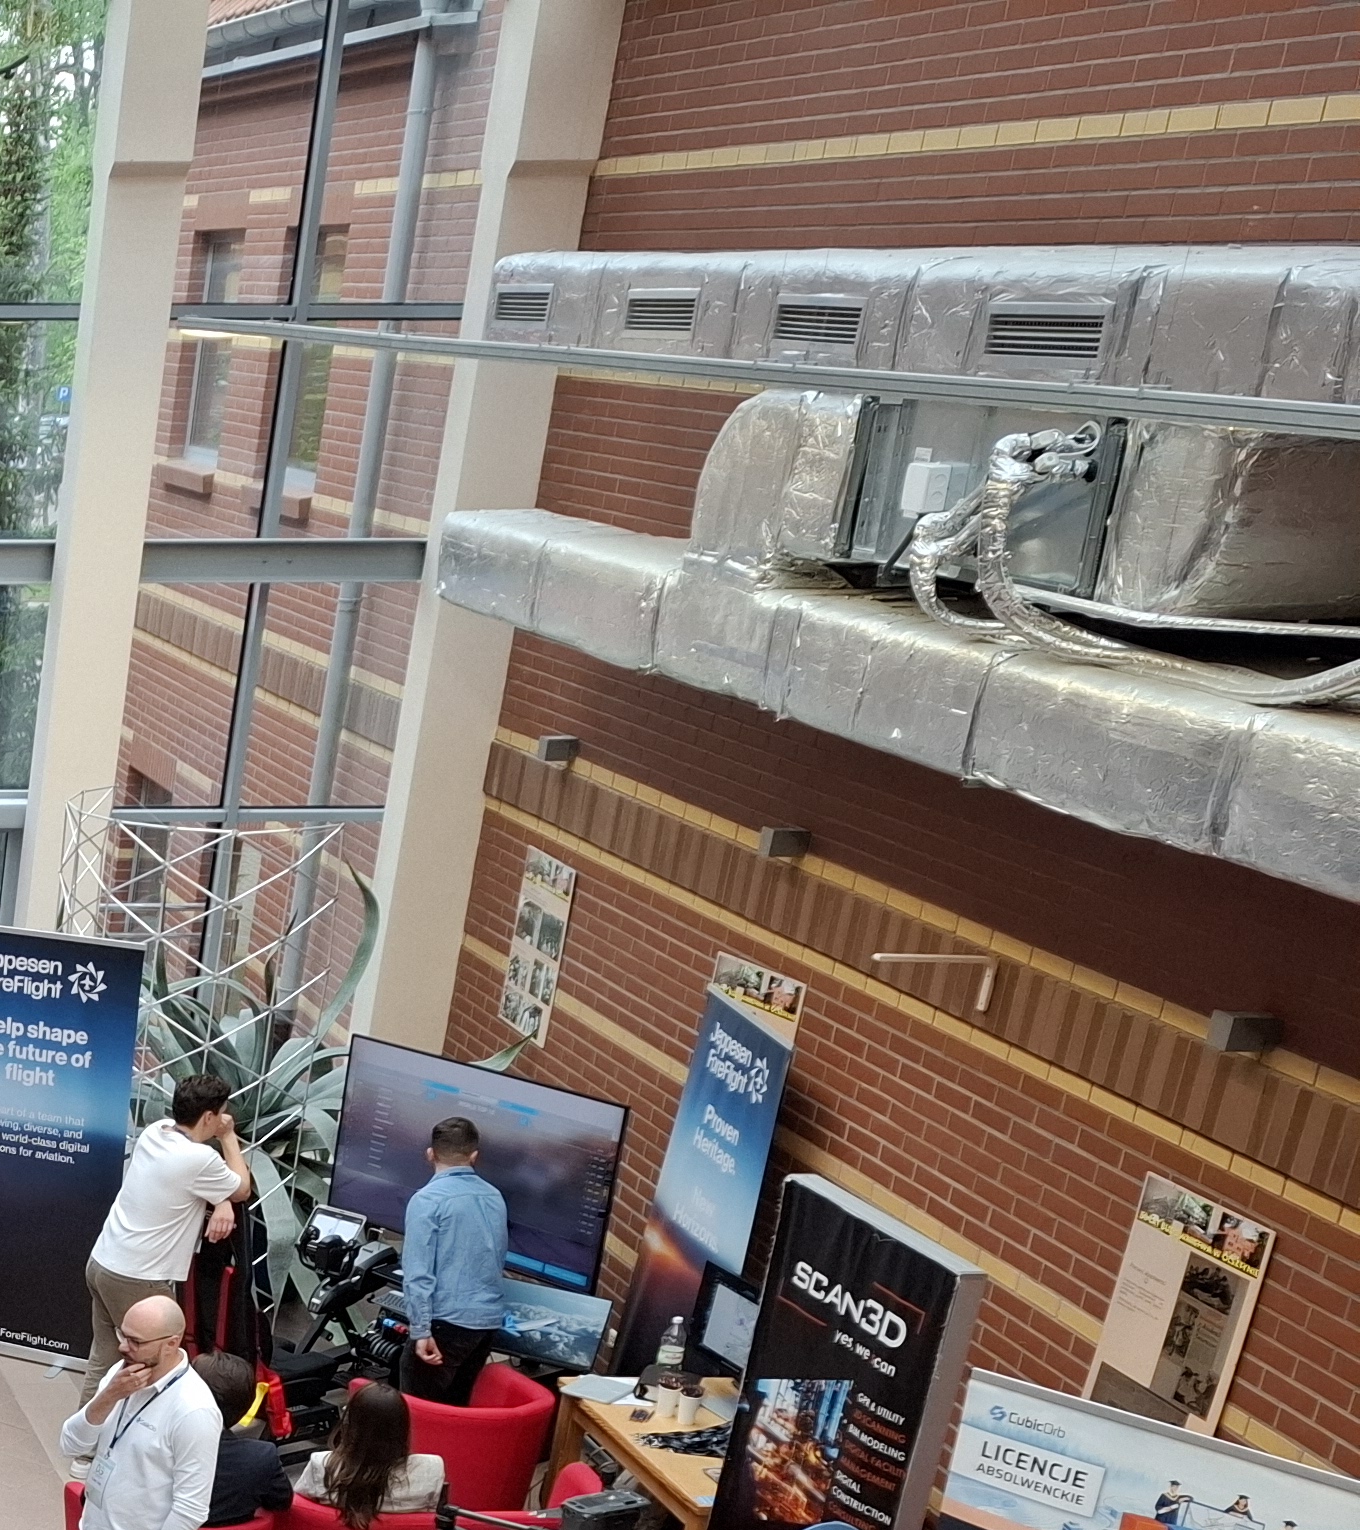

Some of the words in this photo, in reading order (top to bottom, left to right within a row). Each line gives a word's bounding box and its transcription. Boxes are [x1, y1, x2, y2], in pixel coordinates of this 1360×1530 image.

[27, 1021, 89, 1047] shape
[710, 1022, 752, 1069] Jeppesen
[6, 1038, 66, 1066] future
[70, 1050, 92, 1069] of
[4, 1061, 55, 1087] flight
[706, 1048, 749, 1094] ForeFlight
[17, 1108, 26, 1118] of
[29, 1110, 35, 1119] a
[38, 1111, 62, 1124] team
[65, 1114, 85, 1127] that
[23, 1122, 61, 1138] diverse,
[63, 1129, 83, 1140] and
[704, 1104, 740, 1143] Proven
[1, 1130, 57, 1149] world-class
[58, 1139, 90, 1154] digital
[19, 1146, 33, 1157] for
[35, 1150, 75, 1165] aviation.
[692, 1126, 736, 1175] Heritage.
[792, 1261, 907, 1349] SCAN3D
[834, 1328, 855, 1351] yes,
[855, 1343, 871, 1361] we
[874, 1356, 896, 1378] can
[877, 1406, 906, 1425] UTILITY
[1008, 1411, 1066, 1439] CubicOrb
[860, 1434, 906, 1461] MODELING
[981, 1440, 1090, 1490] LICENCJE
[835, 1469, 861, 1494] DIGITAL
[976, 1462, 1085, 1507] ABSOLWENCKIE
[832, 1485, 892, 1526] CONSTRUCTION
